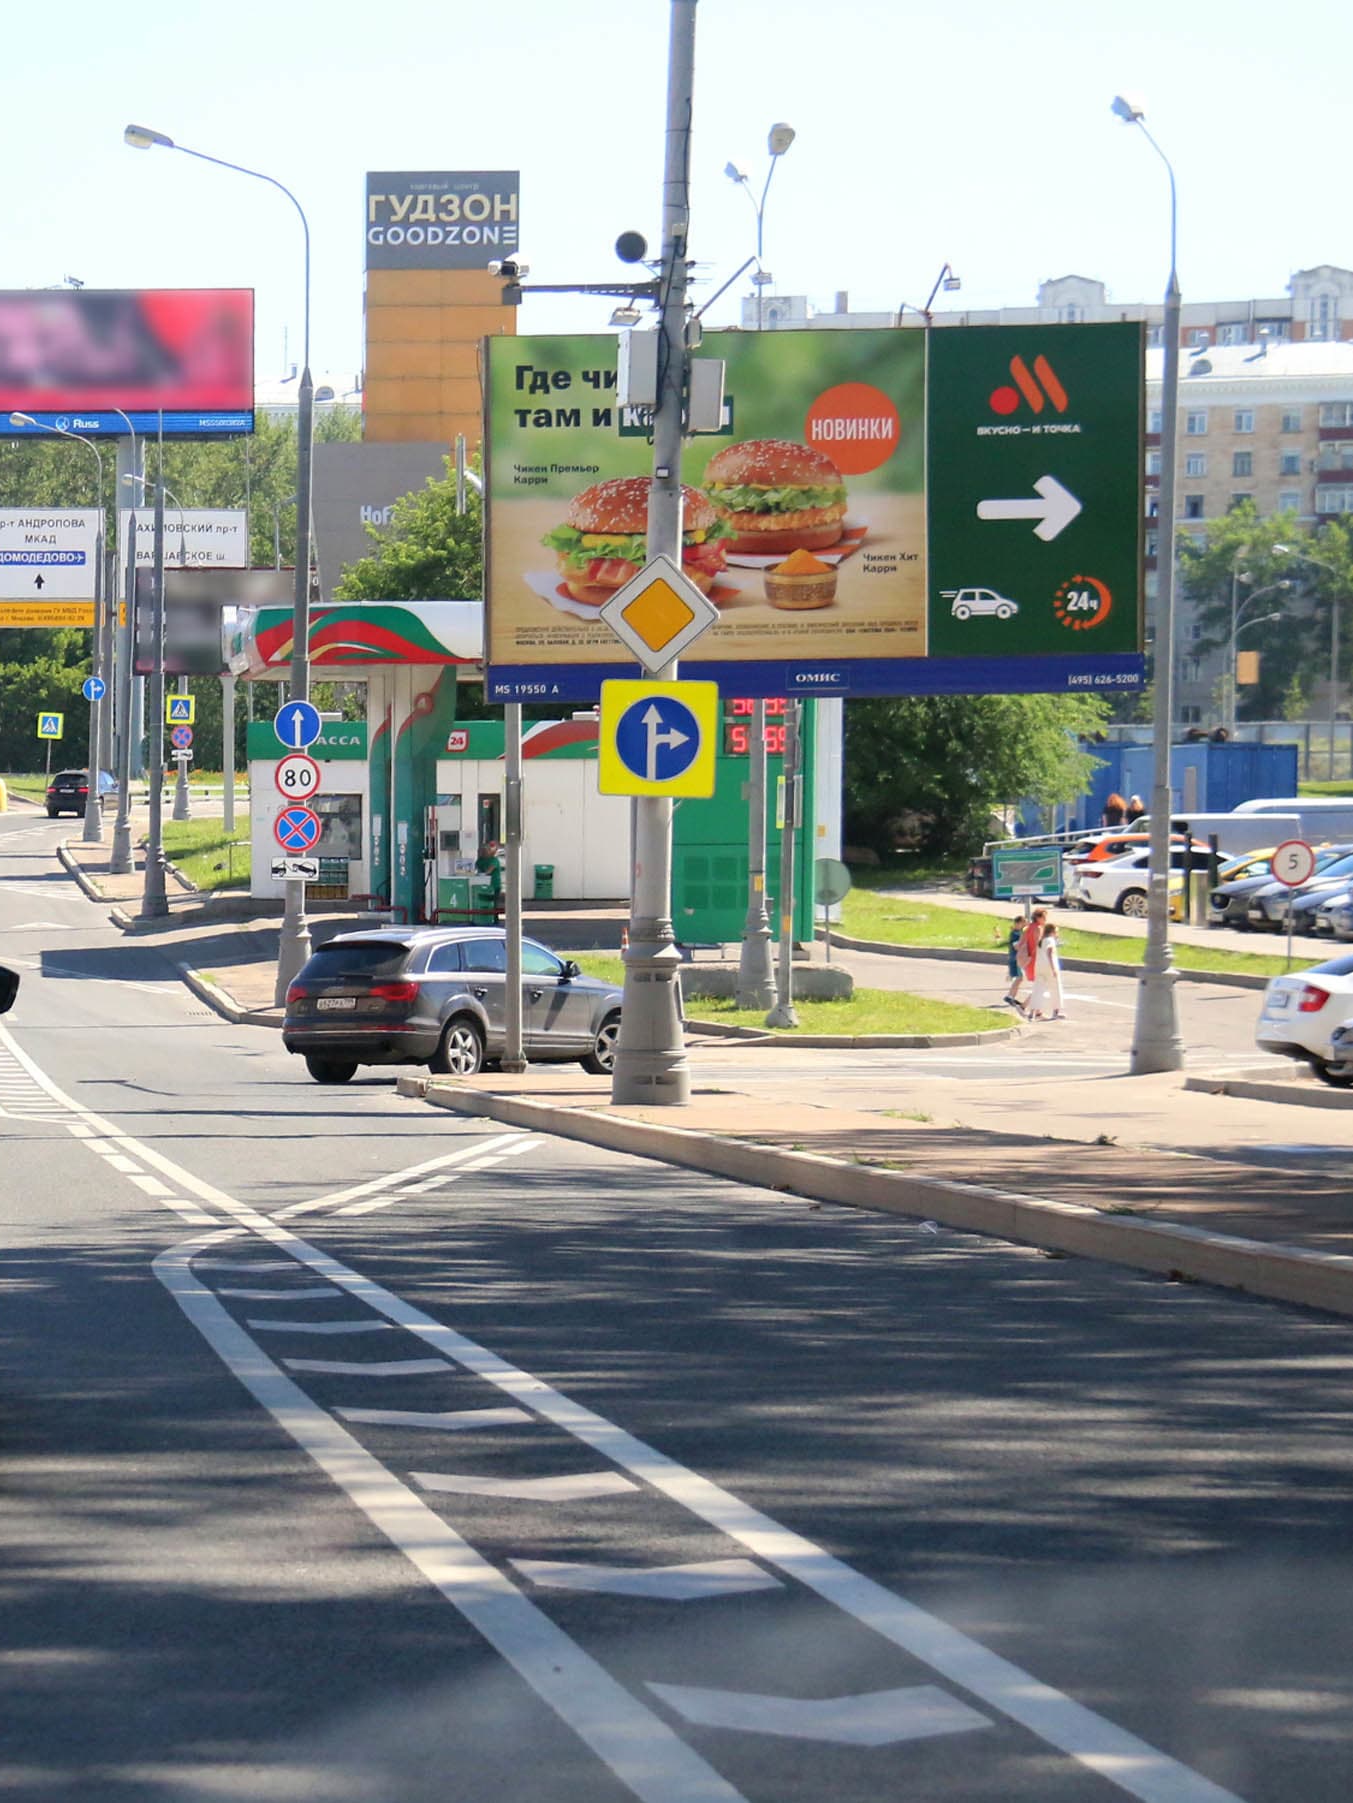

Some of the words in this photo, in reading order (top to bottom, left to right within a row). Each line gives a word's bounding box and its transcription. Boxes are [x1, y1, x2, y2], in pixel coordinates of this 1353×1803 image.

[369, 194, 517, 222] ГУДЗОН
[368, 226, 517, 246] GOODZONE
[515, 365, 571, 394] Где
[73, 418, 100, 429] Russ
[514, 408, 580, 428] там
[593, 408, 612, 428] и
[811, 418, 893, 440] НОВИНКИ
[976, 426, 1021, 436] ВКУСНО
[1032, 425, 1041, 434] И
[1043, 424, 1081, 434] ТОЧКА
[514, 464, 547, 473] Чикен
[550, 464, 600, 474] Премьер
[514, 475, 548, 485] Карри
[17, 518, 86, 529] АНДРОПОВА
[24, 534, 57, 545] МКАД
[862, 553, 897, 562] Чикен
[898, 552, 919, 562] Хит
[862, 563, 897, 574] Карри
[795, 673, 841, 683] ОМИС
[1094, 673, 1139, 684] 626-5200
[495, 685, 510, 695] MS
[515, 684, 546, 694] 19550
[551, 685, 559, 694] A
[450, 736, 464, 746] 24
[284, 769, 312, 788] 80
[1289, 854, 1298, 870] 5
